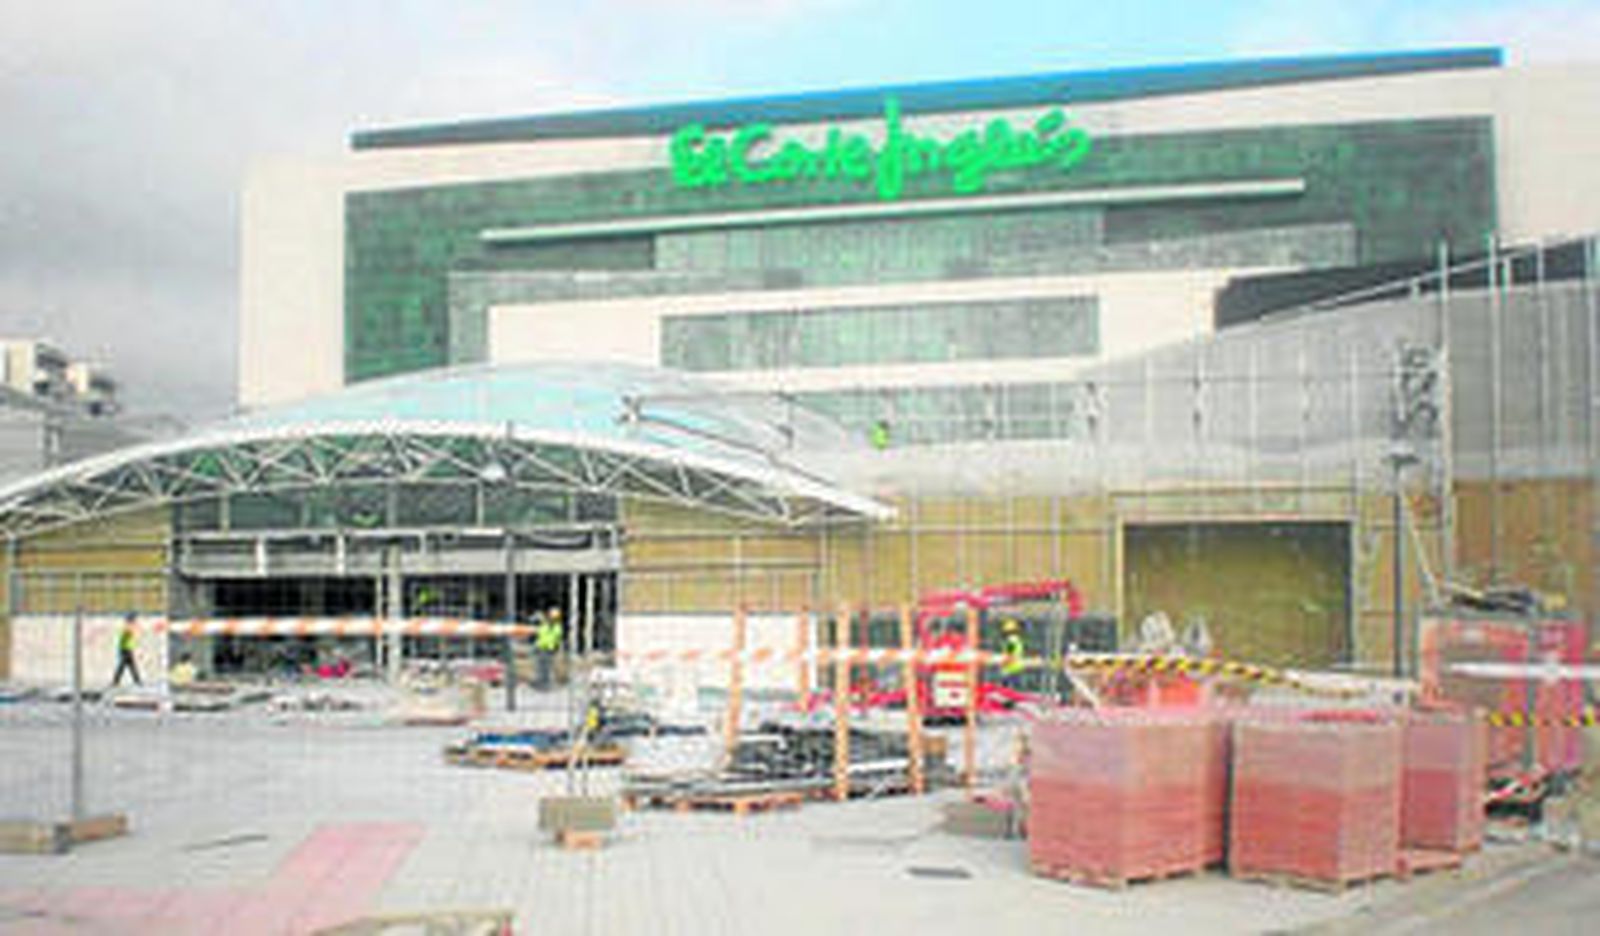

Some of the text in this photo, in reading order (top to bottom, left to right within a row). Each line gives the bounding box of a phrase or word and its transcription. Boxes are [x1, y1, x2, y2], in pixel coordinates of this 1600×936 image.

[671, 96, 1093, 200] El Corte Inglés
